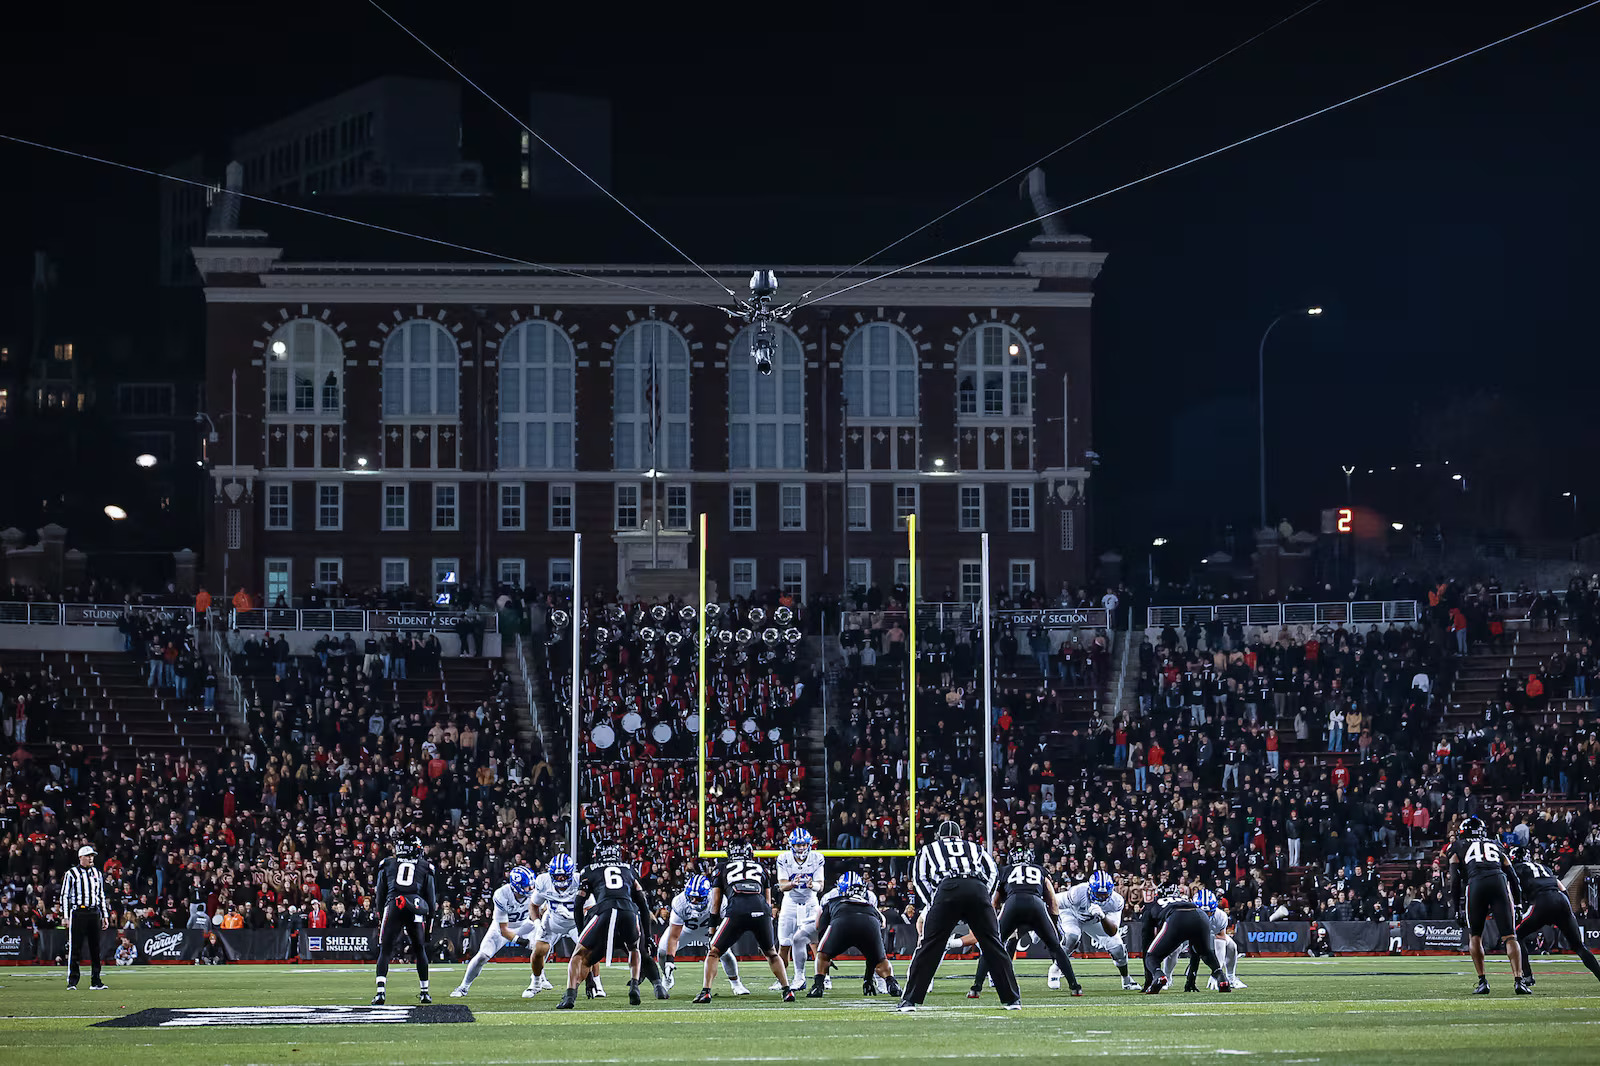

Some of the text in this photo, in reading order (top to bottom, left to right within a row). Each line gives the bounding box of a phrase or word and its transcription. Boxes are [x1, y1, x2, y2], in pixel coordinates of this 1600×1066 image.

[1338, 509, 1352, 531] 2
[387, 616, 428, 625] STUDENT
[1049, 614, 1088, 624] SECTION
[944, 841, 965, 857] U
[1464, 841, 1500, 864] 46
[396, 862, 415, 886] 0
[604, 866, 624, 889] 6
[726, 861, 763, 885] 22
[1007, 866, 1042, 884] 49
[1523, 862, 1551, 878] 11
[1248, 931, 1298, 943] venmo
[1426, 926, 1462, 935] NovaCare
[144, 932, 183, 955] Garage
[326, 936, 368, 945] SHELTER
